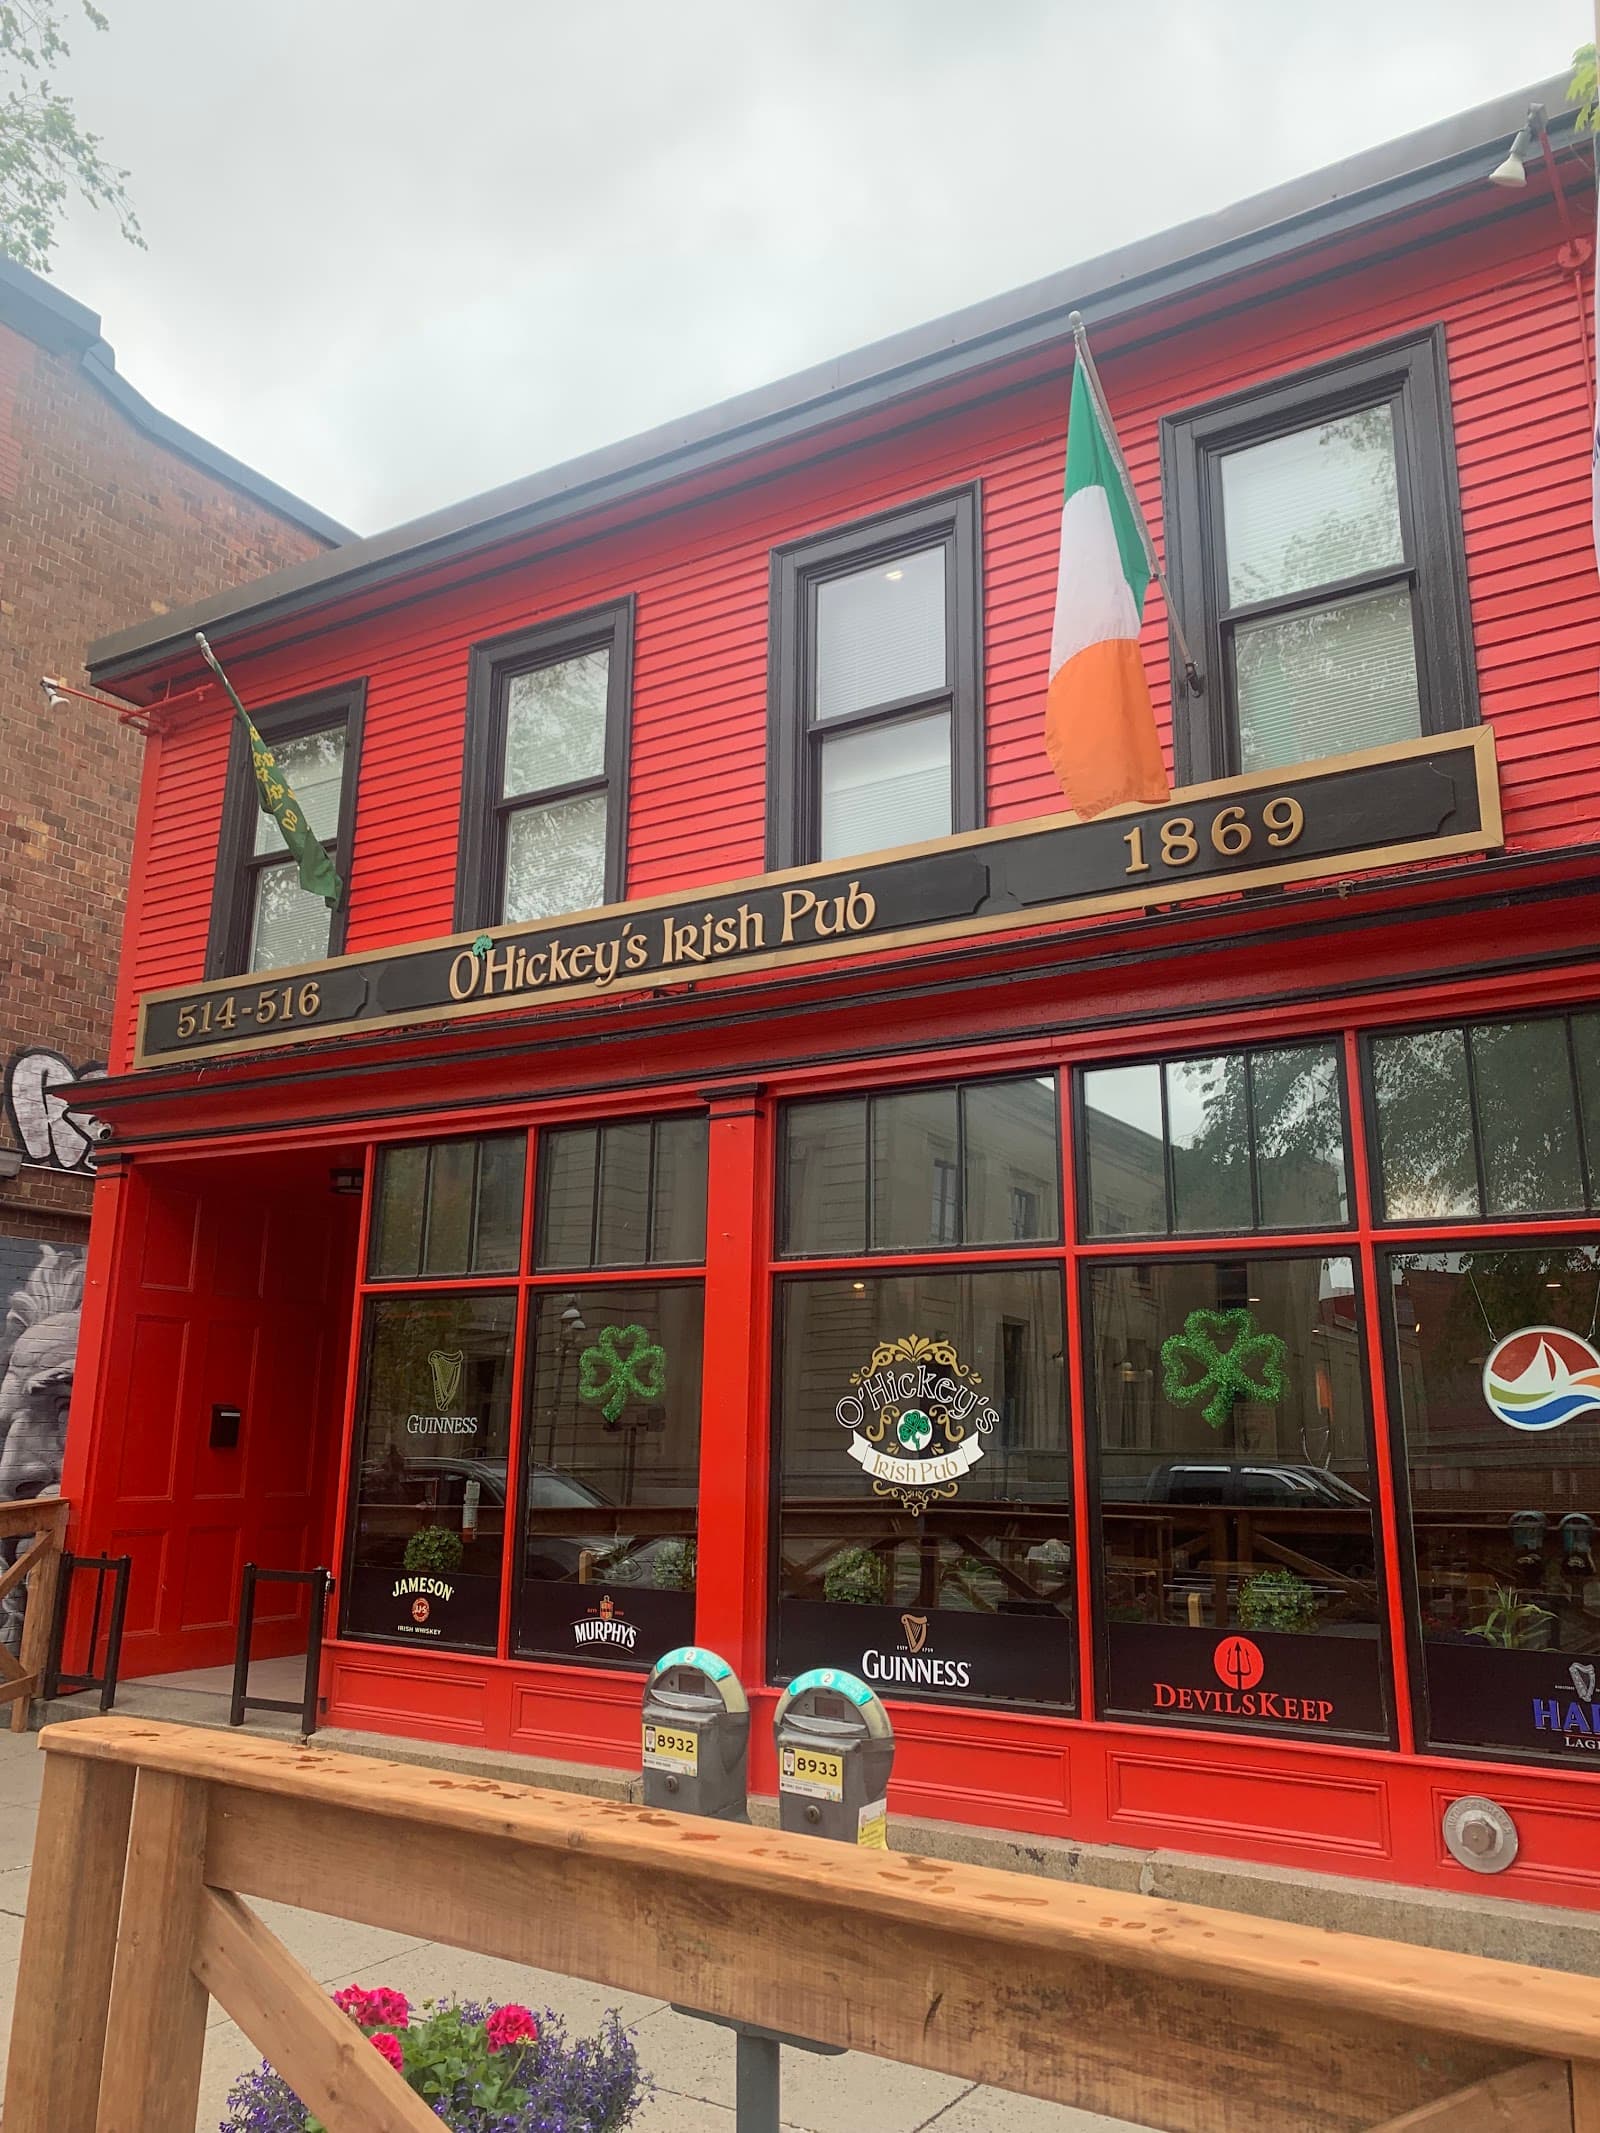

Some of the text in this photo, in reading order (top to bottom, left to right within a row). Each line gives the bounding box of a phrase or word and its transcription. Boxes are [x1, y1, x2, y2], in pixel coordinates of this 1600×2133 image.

[1123, 796, 1304, 875] 1869
[661, 903, 765, 965] Irish
[780, 880, 877, 944] Pub
[176, 981, 321, 1039] 514-516
[835, 1364, 1000, 1435] O'Hickey's
[406, 1414, 479, 1435] GUINNESS
[872, 1454, 959, 1483] Irish Pub
[392, 1576, 454, 1602] JAMESON
[397, 1624, 441, 1636] IRISH WHISKEY
[861, 1649, 971, 1688] GUINNESS
[657, 1734, 695, 1754] 8932
[1565, 1736, 1600, 1750] LAG
[797, 1757, 838, 1777] 8933
